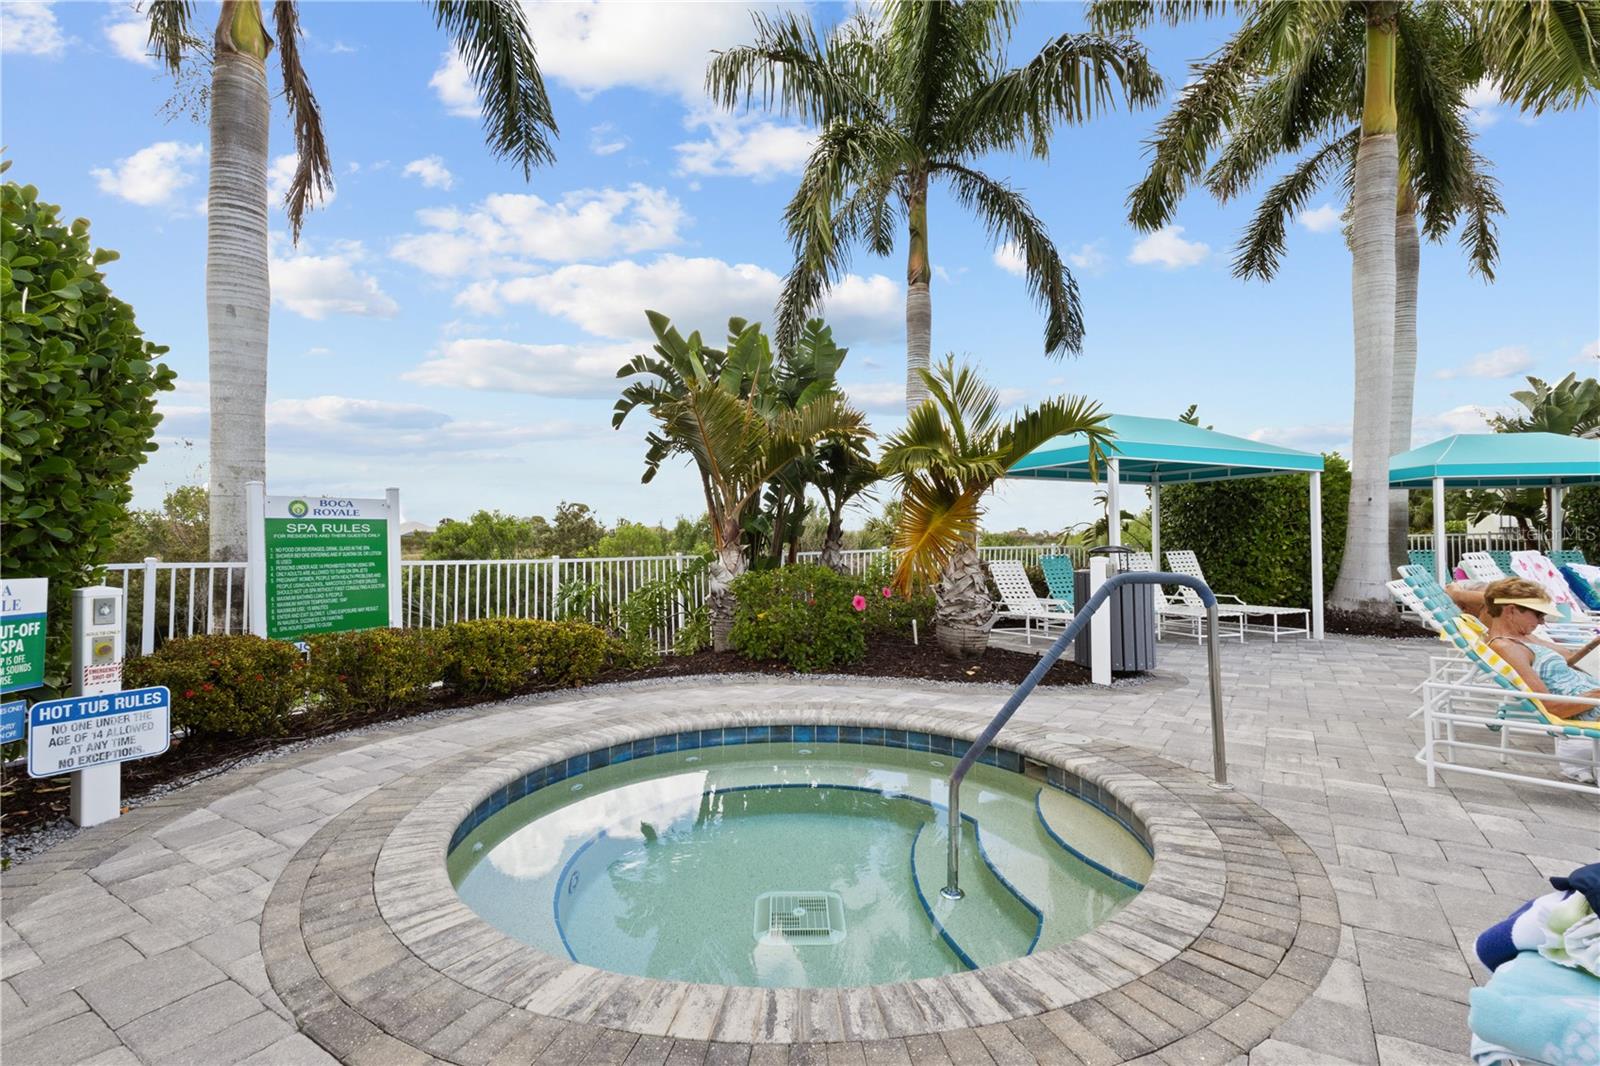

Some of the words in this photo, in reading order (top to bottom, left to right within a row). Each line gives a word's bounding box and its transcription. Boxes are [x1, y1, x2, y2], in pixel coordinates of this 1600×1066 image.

[320, 500, 354, 508] BOCA
[314, 508, 360, 516] ROYALE
[286, 524, 318, 533] SPA
[322, 524, 370, 533] RULES
[1, 638, 24, 655] SPA
[6, 656, 12, 665] IS
[14, 654, 26, 664] OFF
[6, 662, 31, 675] SOUNDS
[8, 704, 23, 713] ONLY
[40, 704, 72, 721] HOT
[78, 700, 109, 715] TUB
[114, 692, 162, 710] RULES
[52, 724, 67, 735] NO
[71, 721, 92, 732] ONE
[96, 715, 130, 727] UNDER
[134, 711, 152, 722] THE
[48, 735, 70, 748] AGE
[74, 732, 87, 743] OF
[92, 730, 103, 740] 14
[106, 722, 154, 738] ALLOWED
[69, 745, 82, 756] AT
[86, 740, 108, 752] ANY
[112, 736, 136, 747] TIME
[58, 758, 74, 769] NO
